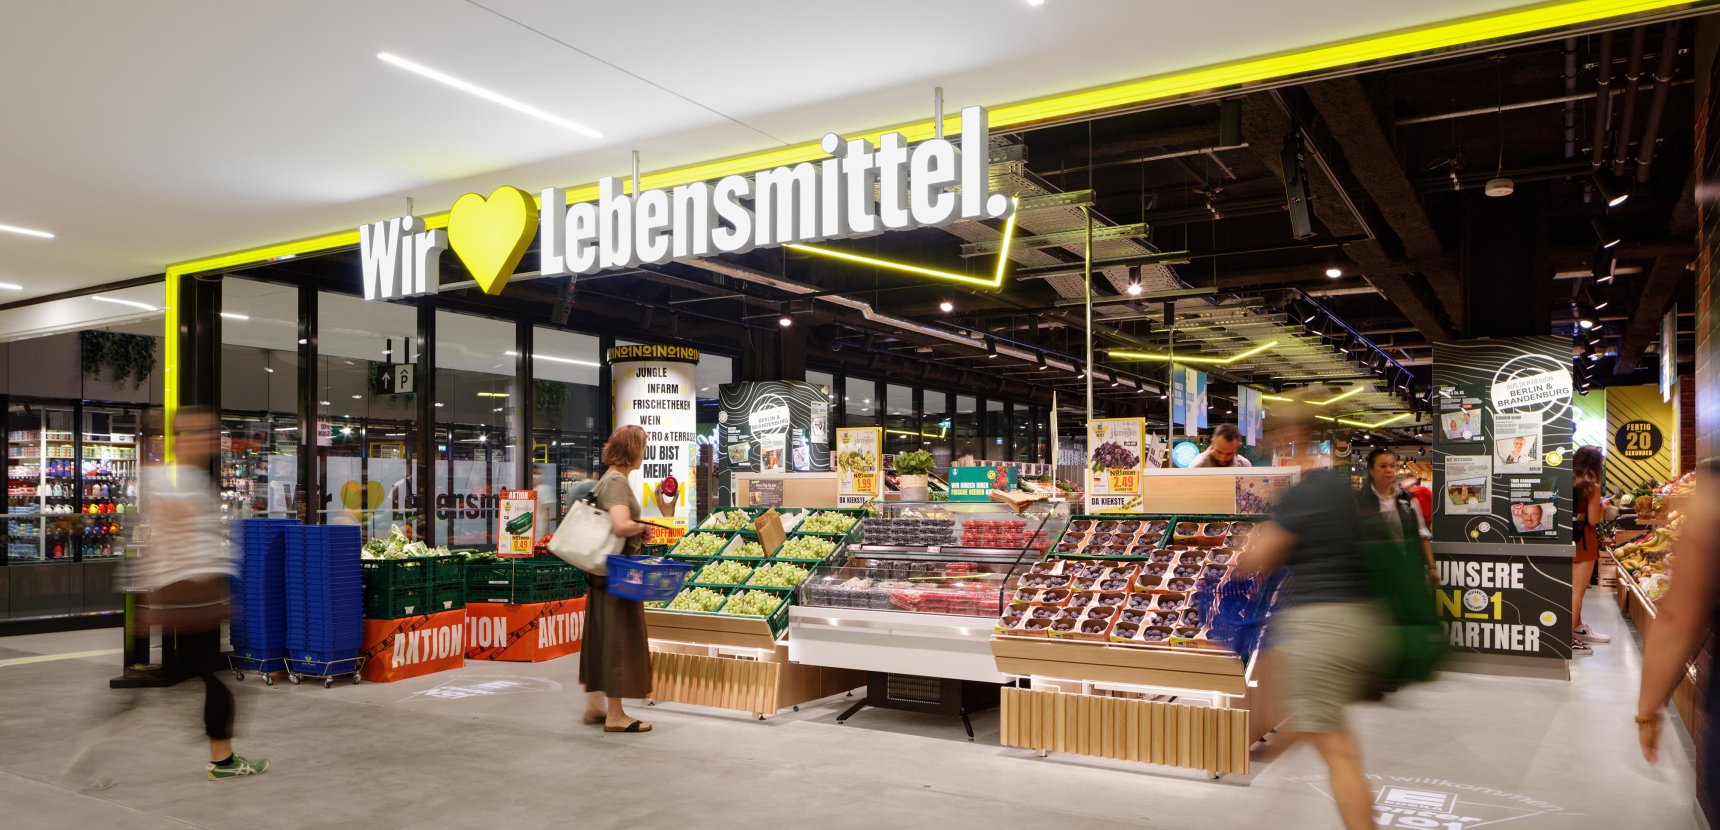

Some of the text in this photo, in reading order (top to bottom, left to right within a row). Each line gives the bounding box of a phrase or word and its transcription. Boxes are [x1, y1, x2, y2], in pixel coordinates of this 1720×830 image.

[360, 106, 1009, 300] Wir Lebensmittel.
[636, 367, 667, 378] JUNGLE
[647, 383, 679, 394] INFARM
[1506, 375, 1554, 390] AUS DER REGION
[1509, 382, 1553, 398] BERLIN &
[1497, 387, 1570, 408] BRANDENBURG
[633, 399, 691, 411] FRISCHETHEKEN
[639, 415, 661, 426] WEIN
[752, 418, 789, 431] BRANDENBURG
[758, 416, 776, 424] BERLIN
[1626, 423, 1652, 431] FERTIG
[648, 431, 663, 442] TRO
[664, 432, 670, 441] &
[1626, 431, 1652, 450] 20
[643, 445, 680, 461] DU BIST
[643, 463, 673, 479] MEINE
[857, 478, 872, 489] 1.99
[1113, 476, 1134, 488] 2.49
[508, 491, 529, 500] AKTION
[1091, 497, 1125, 506] DA KIEKSTE
[1435, 560, 1524, 589] UNSERE
[392, 624, 463, 668] AKTION
[1372, 804, 1482, 822] enter
